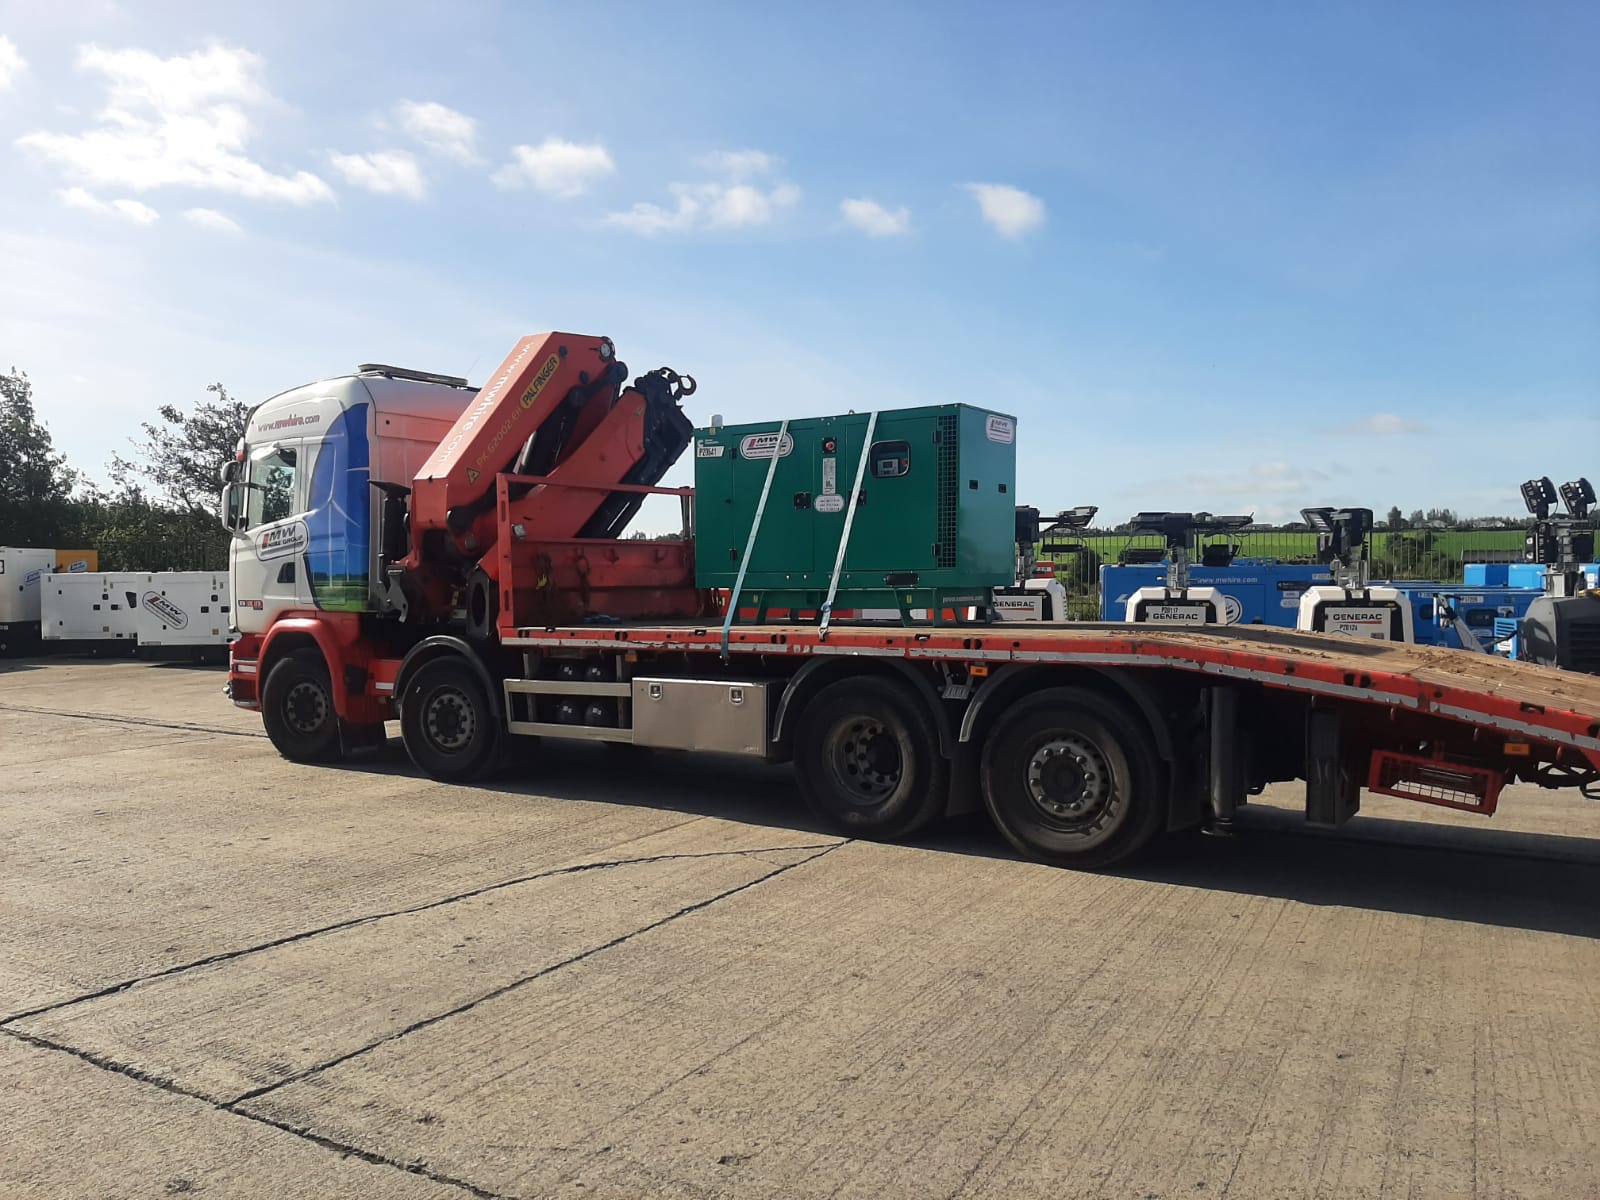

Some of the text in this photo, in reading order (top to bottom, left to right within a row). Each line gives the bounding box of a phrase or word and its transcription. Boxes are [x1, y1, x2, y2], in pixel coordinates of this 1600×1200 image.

[522, 356, 558, 406] PALFINGER
[438, 341, 534, 464] www.mwhire.com
[270, 525, 297, 541] MW
[1333, 613, 1383, 621] GENERAC
